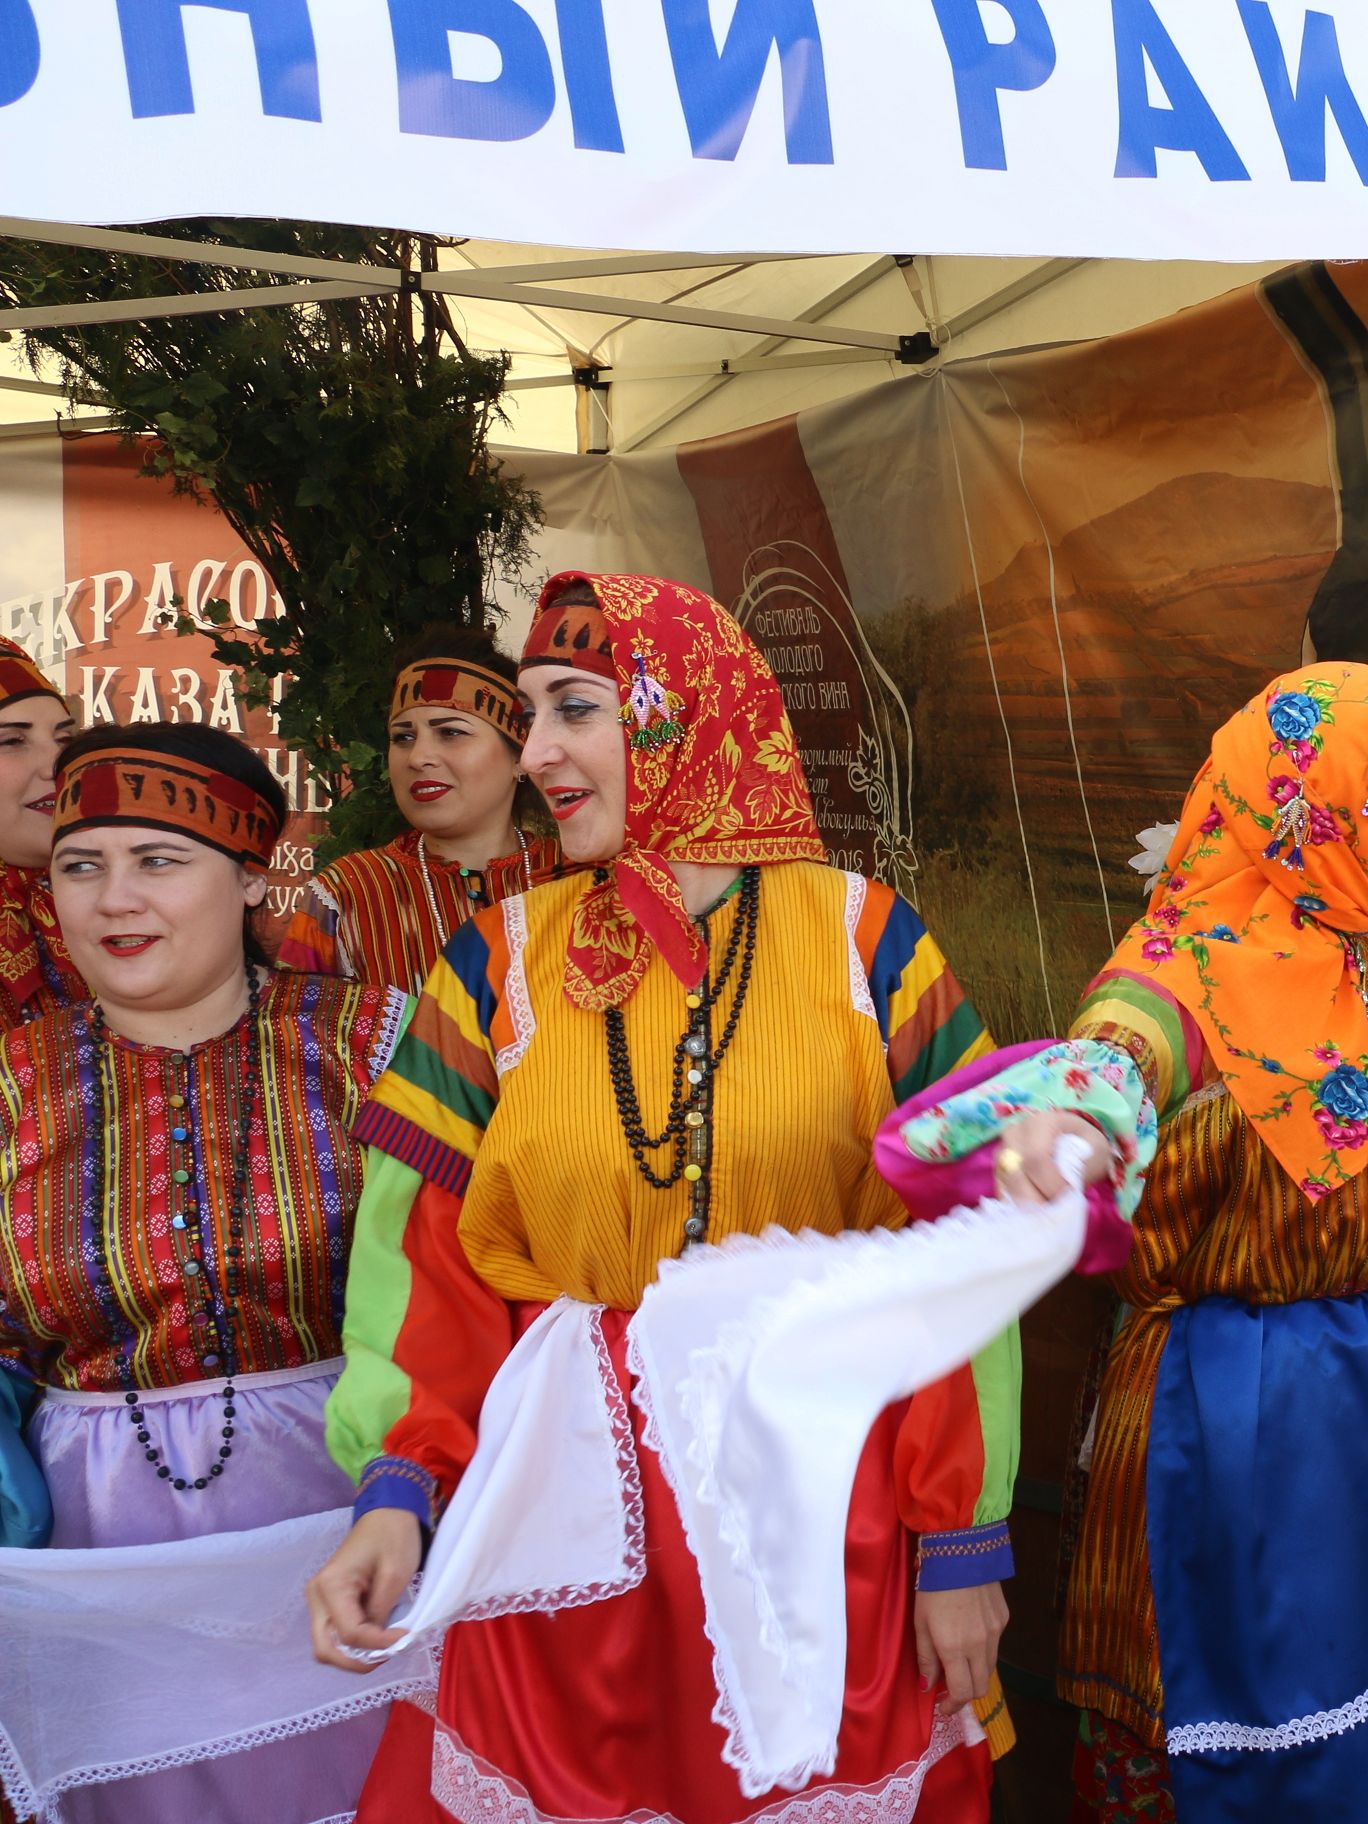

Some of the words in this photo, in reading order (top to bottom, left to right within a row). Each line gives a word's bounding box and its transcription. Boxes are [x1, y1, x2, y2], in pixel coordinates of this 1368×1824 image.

[755, 606, 821, 637] ФЕСТИВАЛЬ
[778, 683, 816, 710] СКОГО
[819, 681, 851, 709] ВИНА
